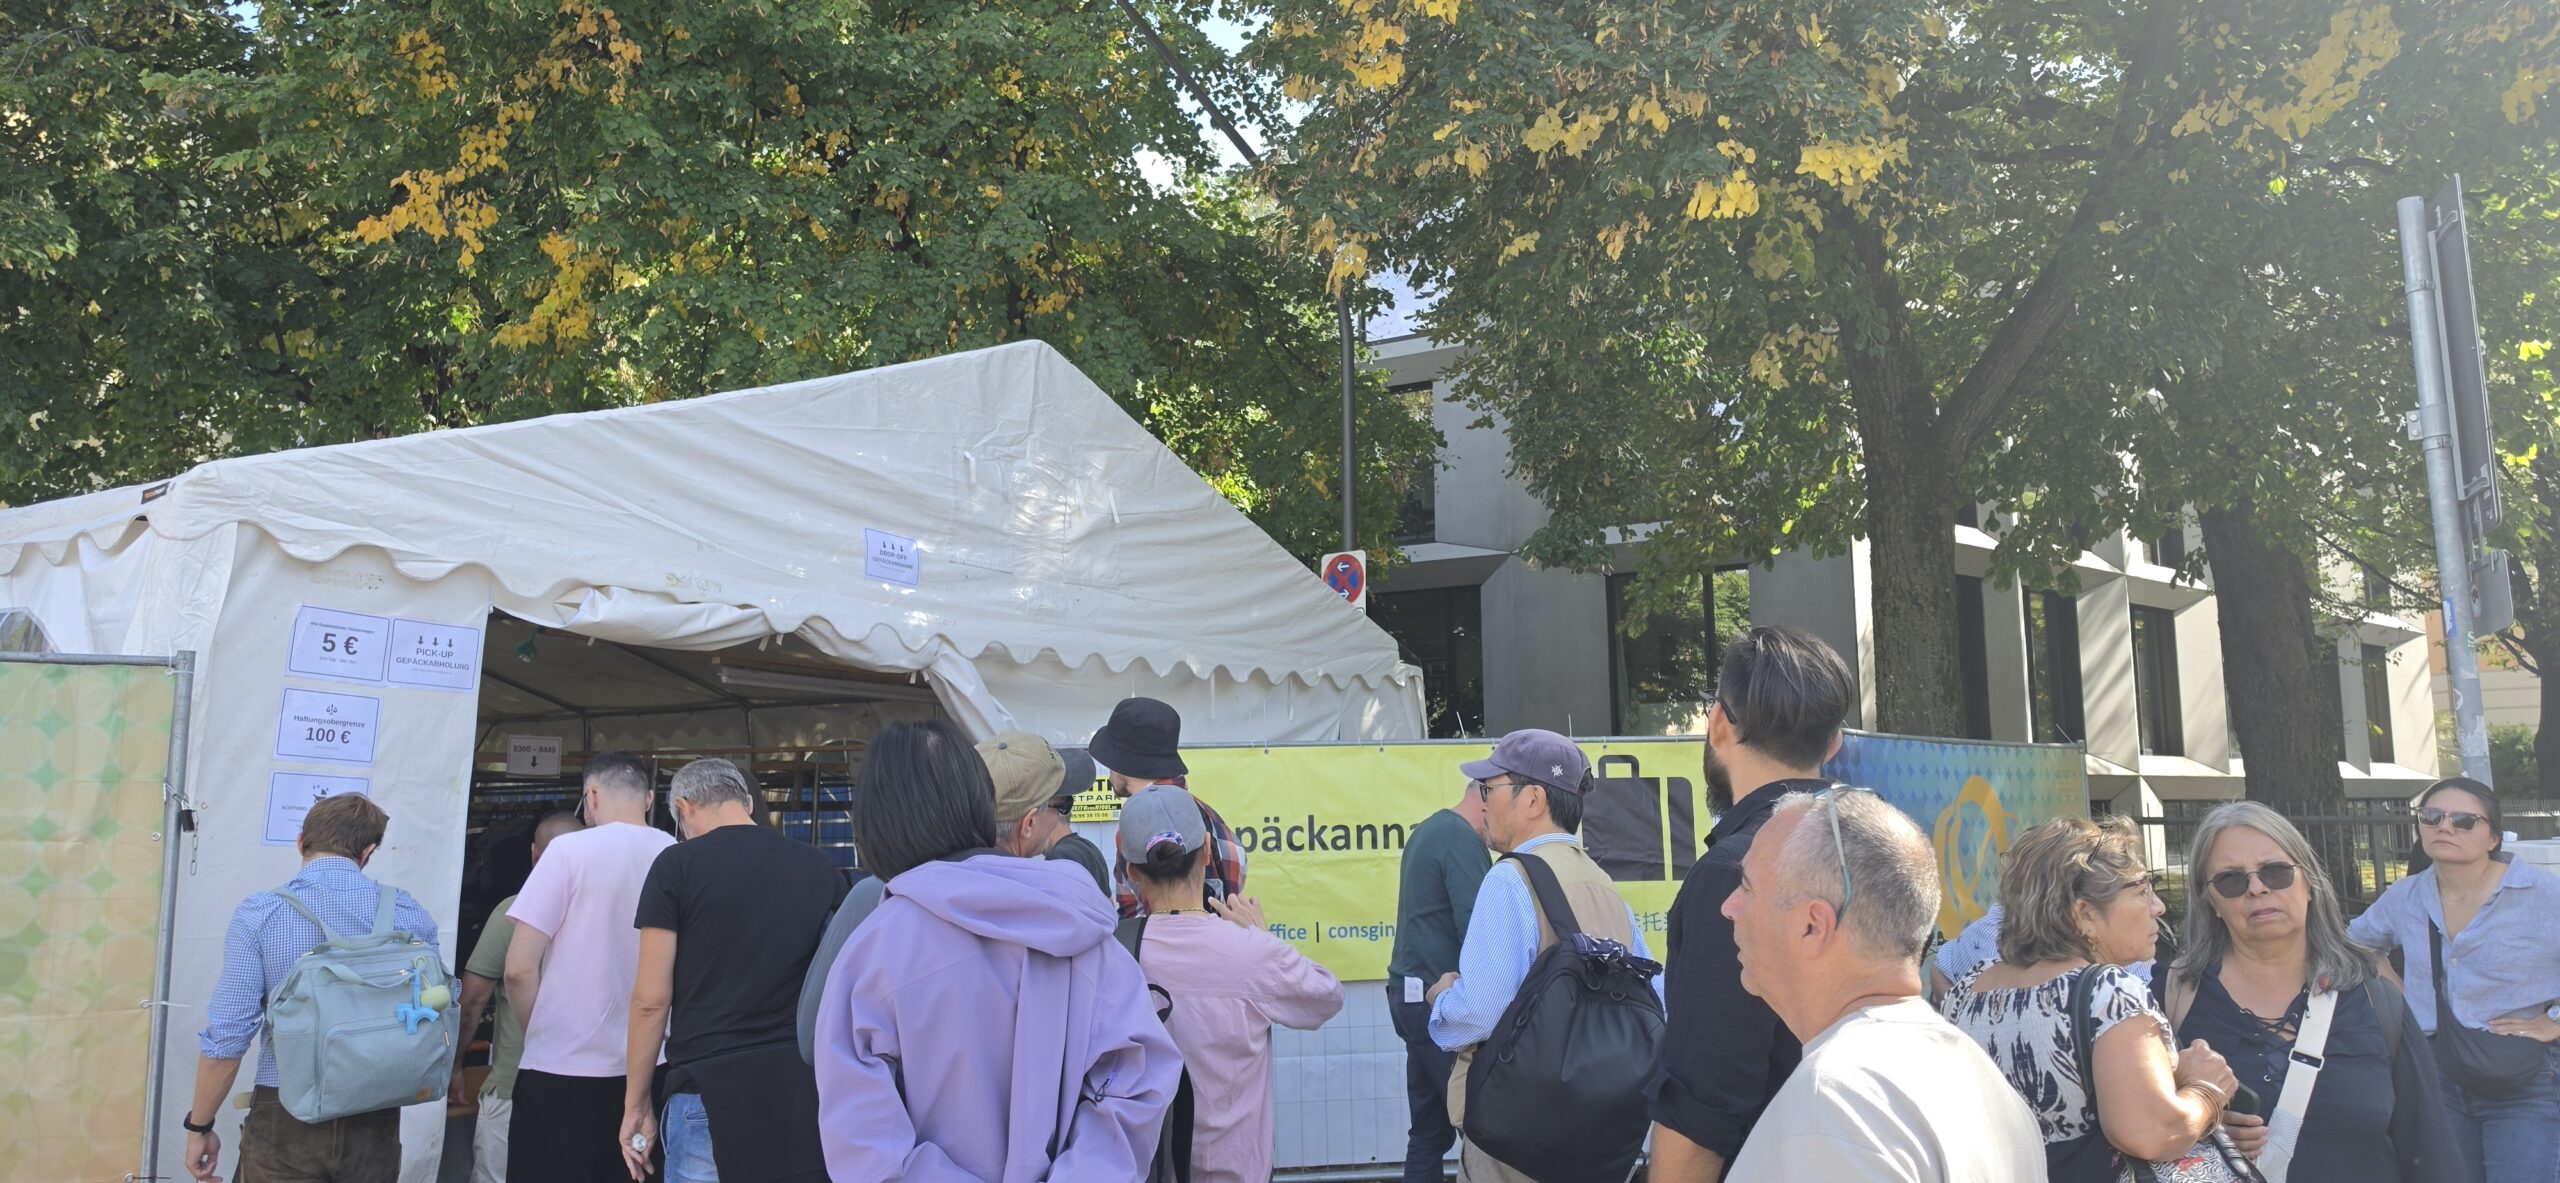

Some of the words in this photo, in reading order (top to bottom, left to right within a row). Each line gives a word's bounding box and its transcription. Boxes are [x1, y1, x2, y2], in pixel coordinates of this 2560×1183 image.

[880, 549, 907, 560] DROP-OFF
[322, 632, 337, 653] 5
[343, 636, 359, 656] €
[416, 647, 454, 659] PICK-UP
[395, 656, 470, 671] GEPÄCKABHOLUNG
[293, 714, 366, 728] Haftungsobergrenze
[305, 727, 336, 743] 100
[341, 730, 352, 744] €
[1235, 815, 1421, 852] päckann
[1328, 921, 1395, 941] consgin
